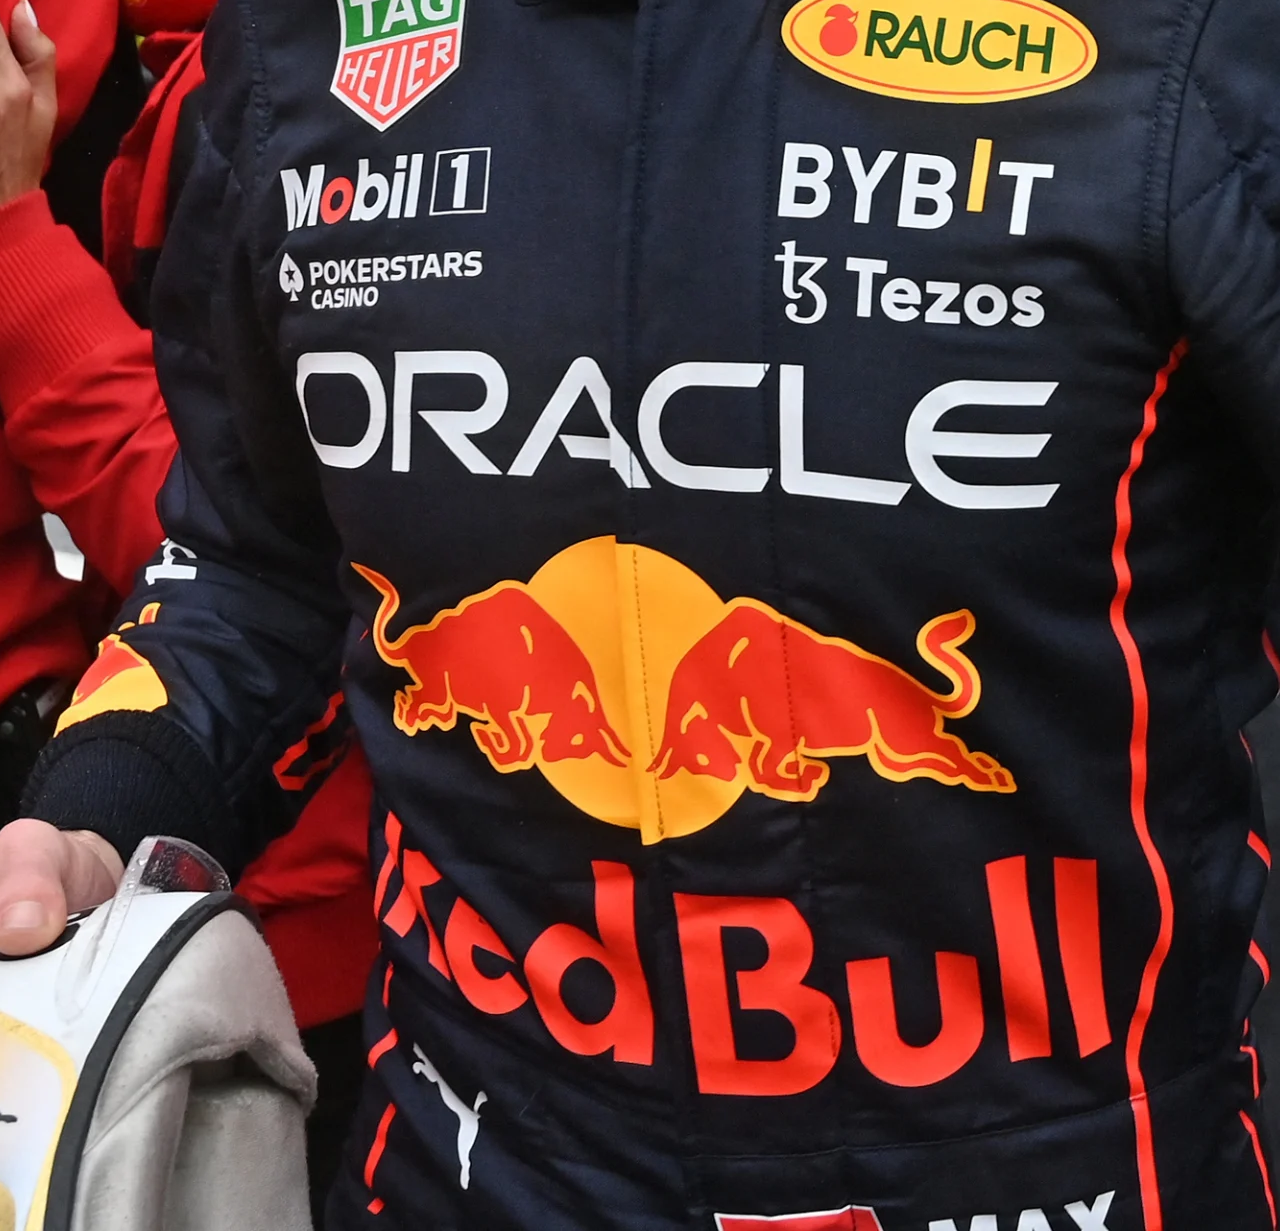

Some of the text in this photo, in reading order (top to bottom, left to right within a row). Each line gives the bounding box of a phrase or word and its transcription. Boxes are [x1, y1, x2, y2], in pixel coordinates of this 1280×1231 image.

[341, 35, 453, 116] HEUER
[864, 9, 1056, 74] RAUCH
[280, 153, 470, 232] Mobil 1
[777, 137, 1055, 236] BYBIT
[308, 250, 483, 286] POKERSTARS
[311, 285, 380, 310] CASINO
[846, 256, 1045, 328] Tezos
[295, 350, 1061, 511] ORACLE
[673, 854, 1112, 1096] Bull
